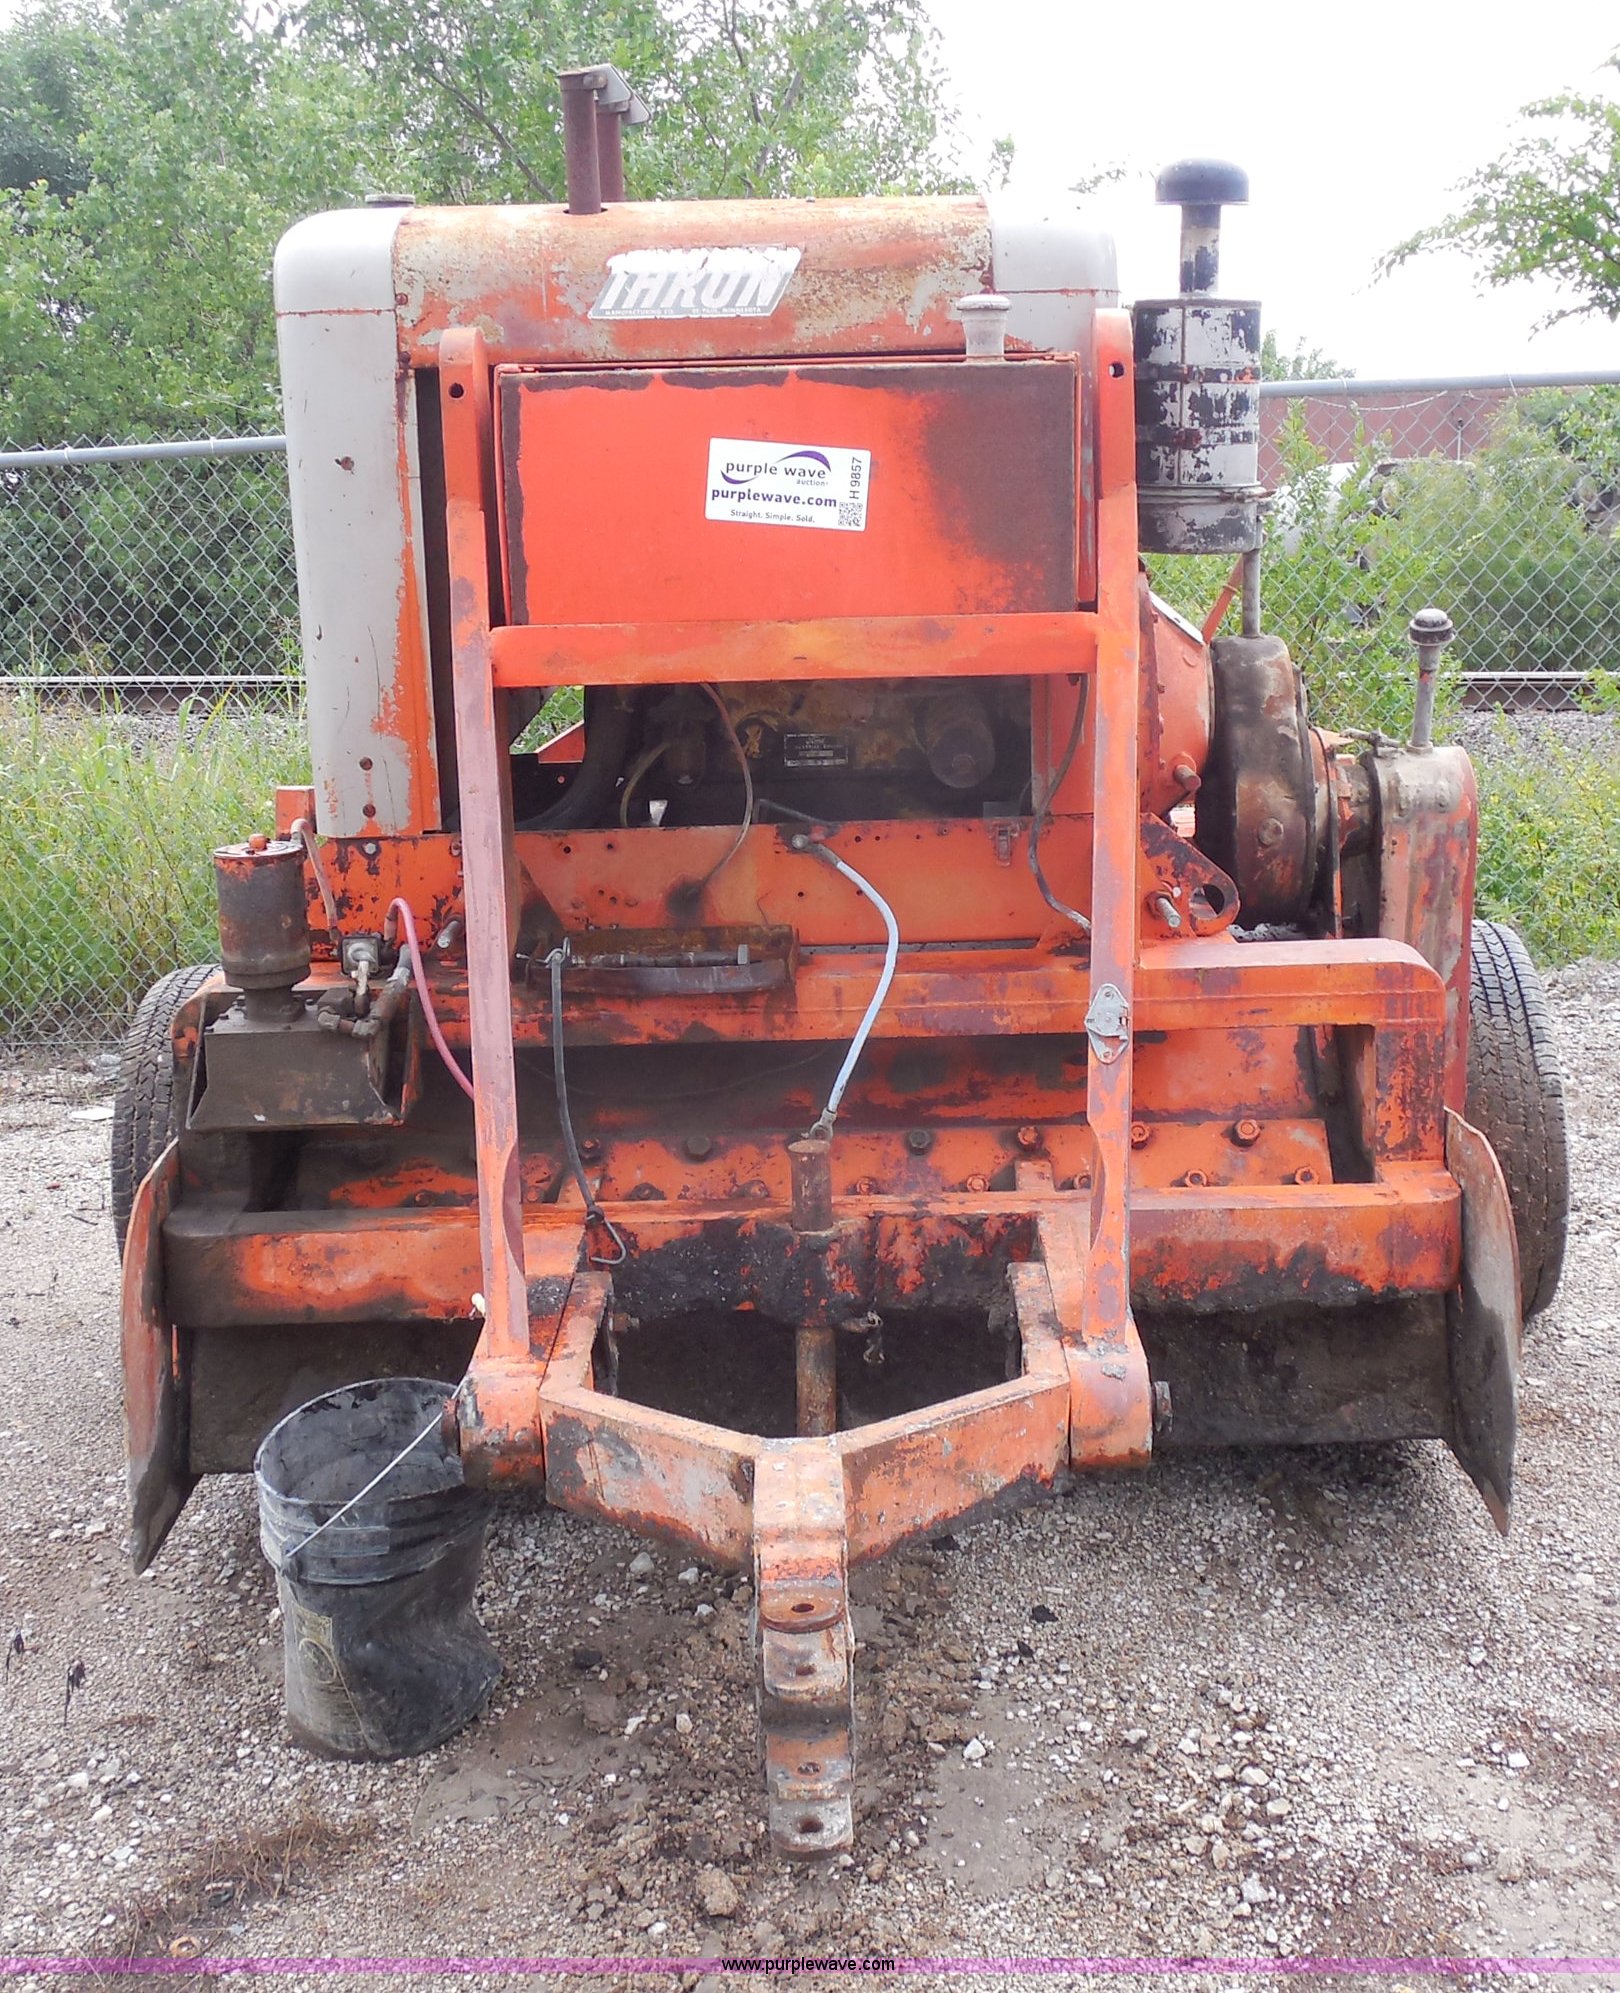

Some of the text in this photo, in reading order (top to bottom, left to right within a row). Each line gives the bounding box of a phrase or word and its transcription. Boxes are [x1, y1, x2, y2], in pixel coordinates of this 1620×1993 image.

[726, 462, 826, 479] purple wave
[796, 478, 826, 487] auction
[711, 488, 837, 508] purplewave.com
[730, 509, 816, 523] Straight. Simple. Sold.
